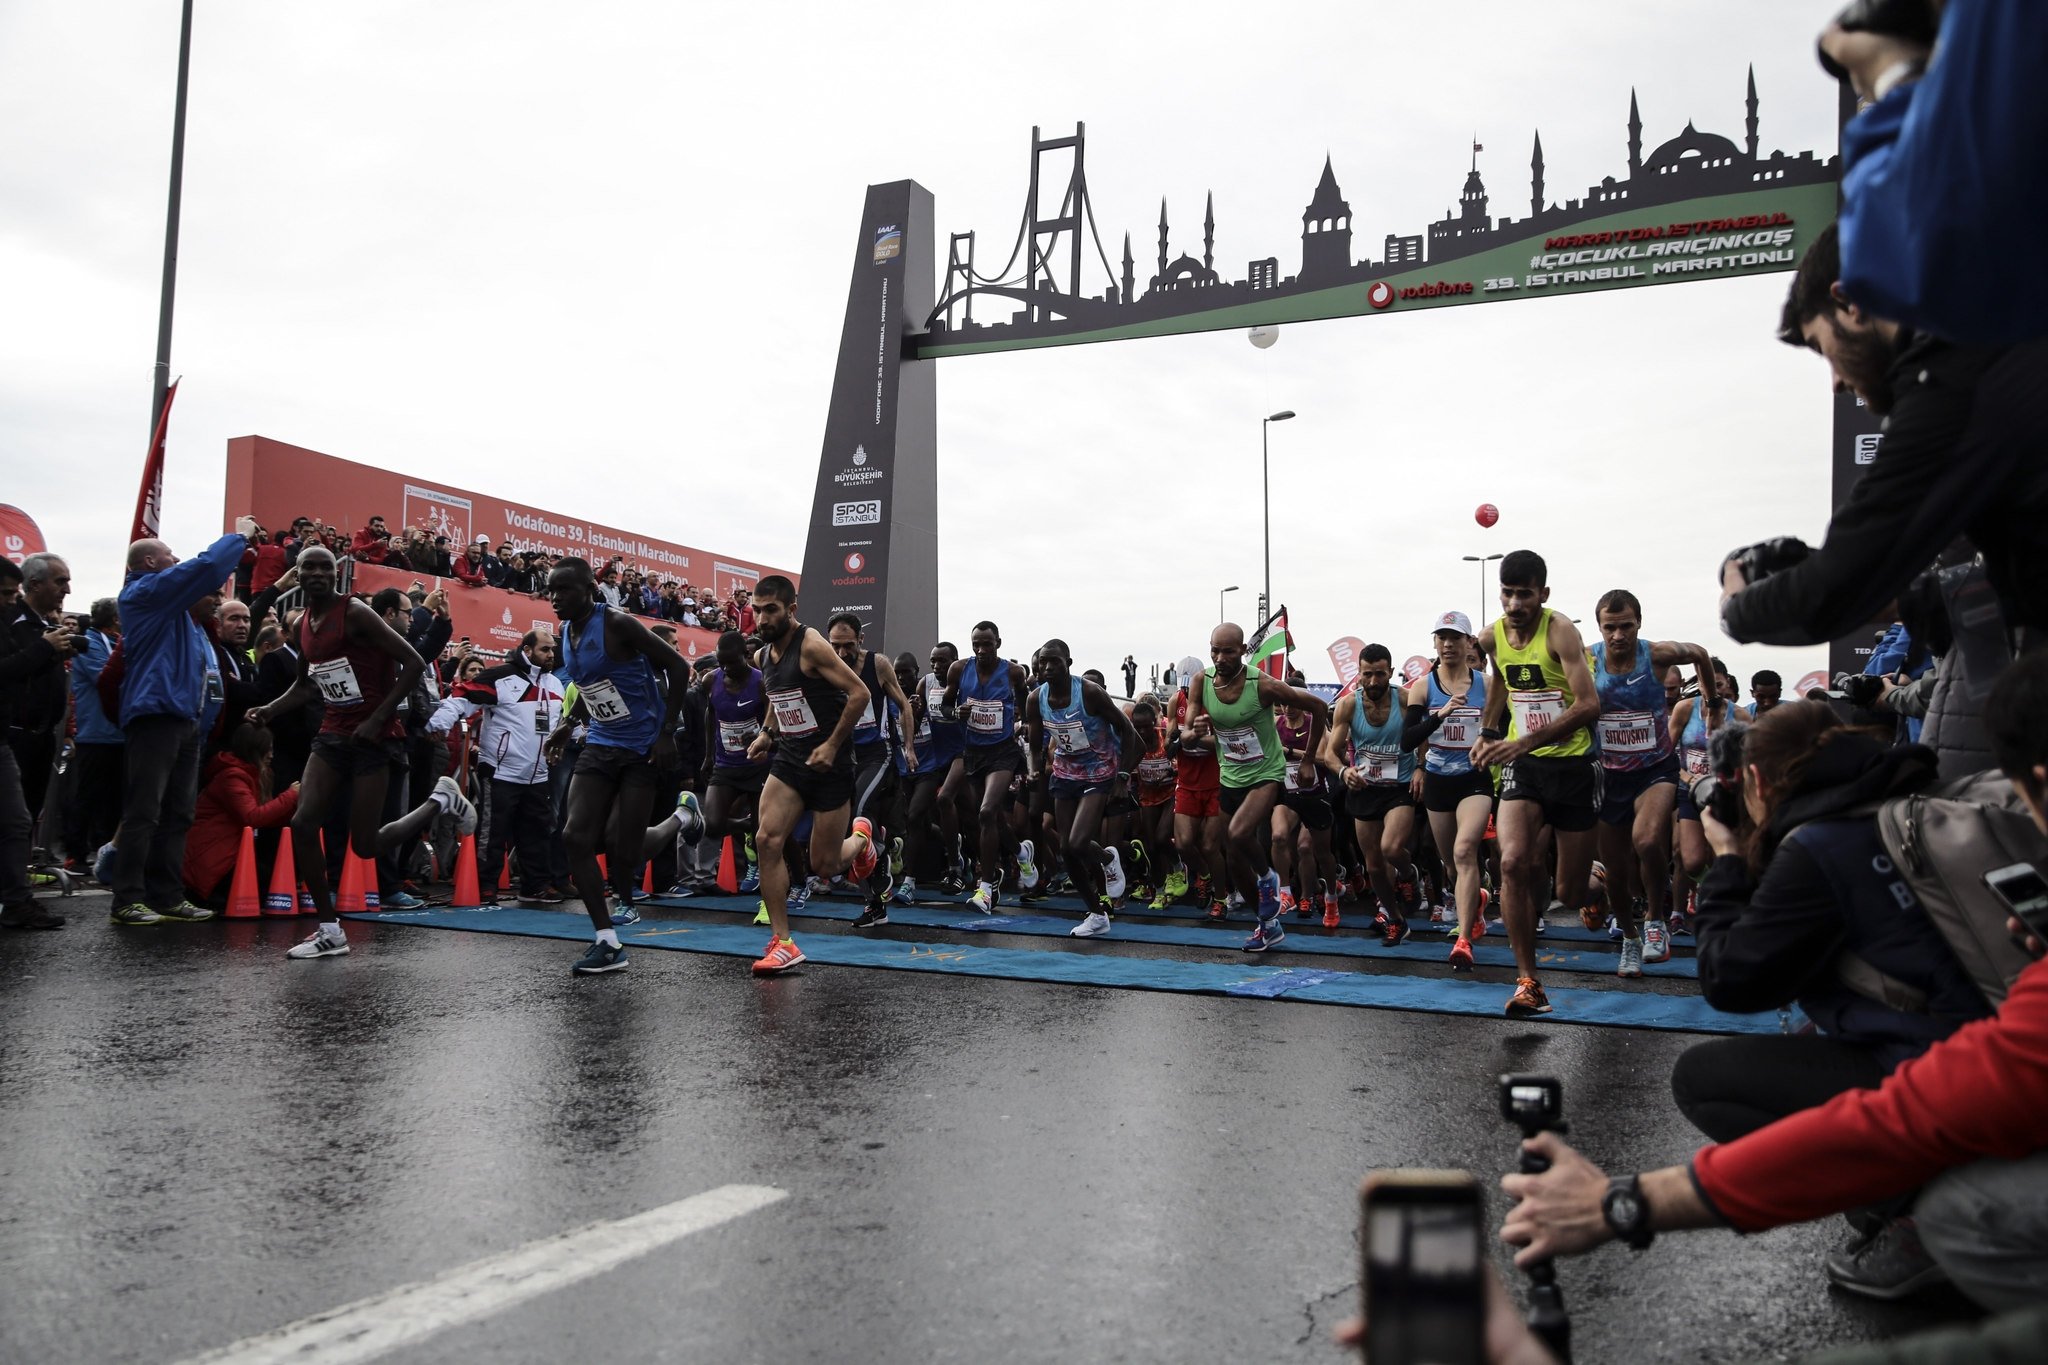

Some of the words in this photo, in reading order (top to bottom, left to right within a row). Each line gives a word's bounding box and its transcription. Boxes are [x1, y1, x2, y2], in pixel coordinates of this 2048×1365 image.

[877, 224, 896, 234] IAAF
[1398, 281, 1474, 301] vodafone
[1483, 277, 1520, 291] 39.
[1525, 265, 1645, 288] İSTANBUL
[1652, 249, 1794, 276] MARATONU
[880, 278, 888, 322] MARATONU
[834, 470, 883, 482] BÜYÜKŞEHİR
[836, 503, 877, 516] SPOR
[505, 508, 566, 537] Vodafone
[568, 525, 585, 542] 39.
[588, 525, 635, 555] İstanbul
[638, 542, 689, 568] Maratonu
[832, 575, 875, 586] vodafone
[1443, 726, 1465, 741] YILDIZ
